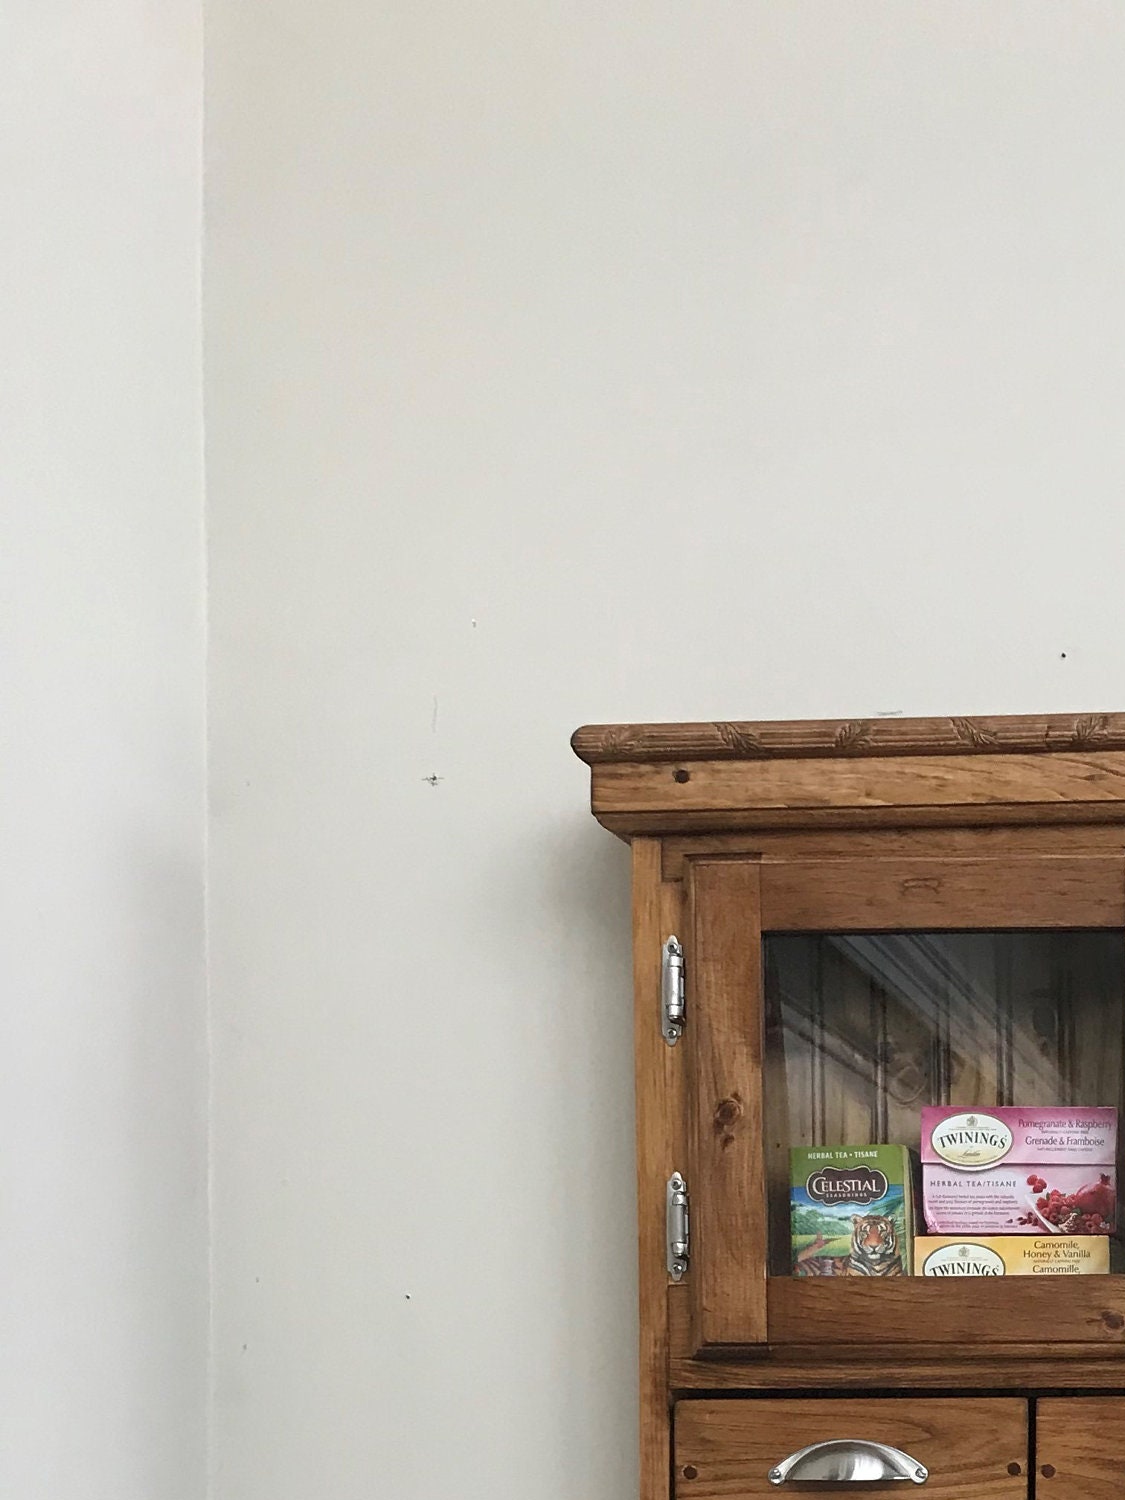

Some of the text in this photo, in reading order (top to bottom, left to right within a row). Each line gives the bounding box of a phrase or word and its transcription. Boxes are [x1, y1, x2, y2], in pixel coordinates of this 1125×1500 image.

[1018, 1119, 1111, 1130] Pomegranate & Raspberry
[938, 1132, 1007, 1149] TWININGS
[1025, 1136, 1104, 1146] Grenade & Framboise
[812, 1177, 880, 1195] CELESTIAL
[1034, 1240, 1079, 1250] Camomile,
[1023, 1249, 1091, 1260] Honey & Vanilla
[930, 1262, 999, 1276] TWININGS
